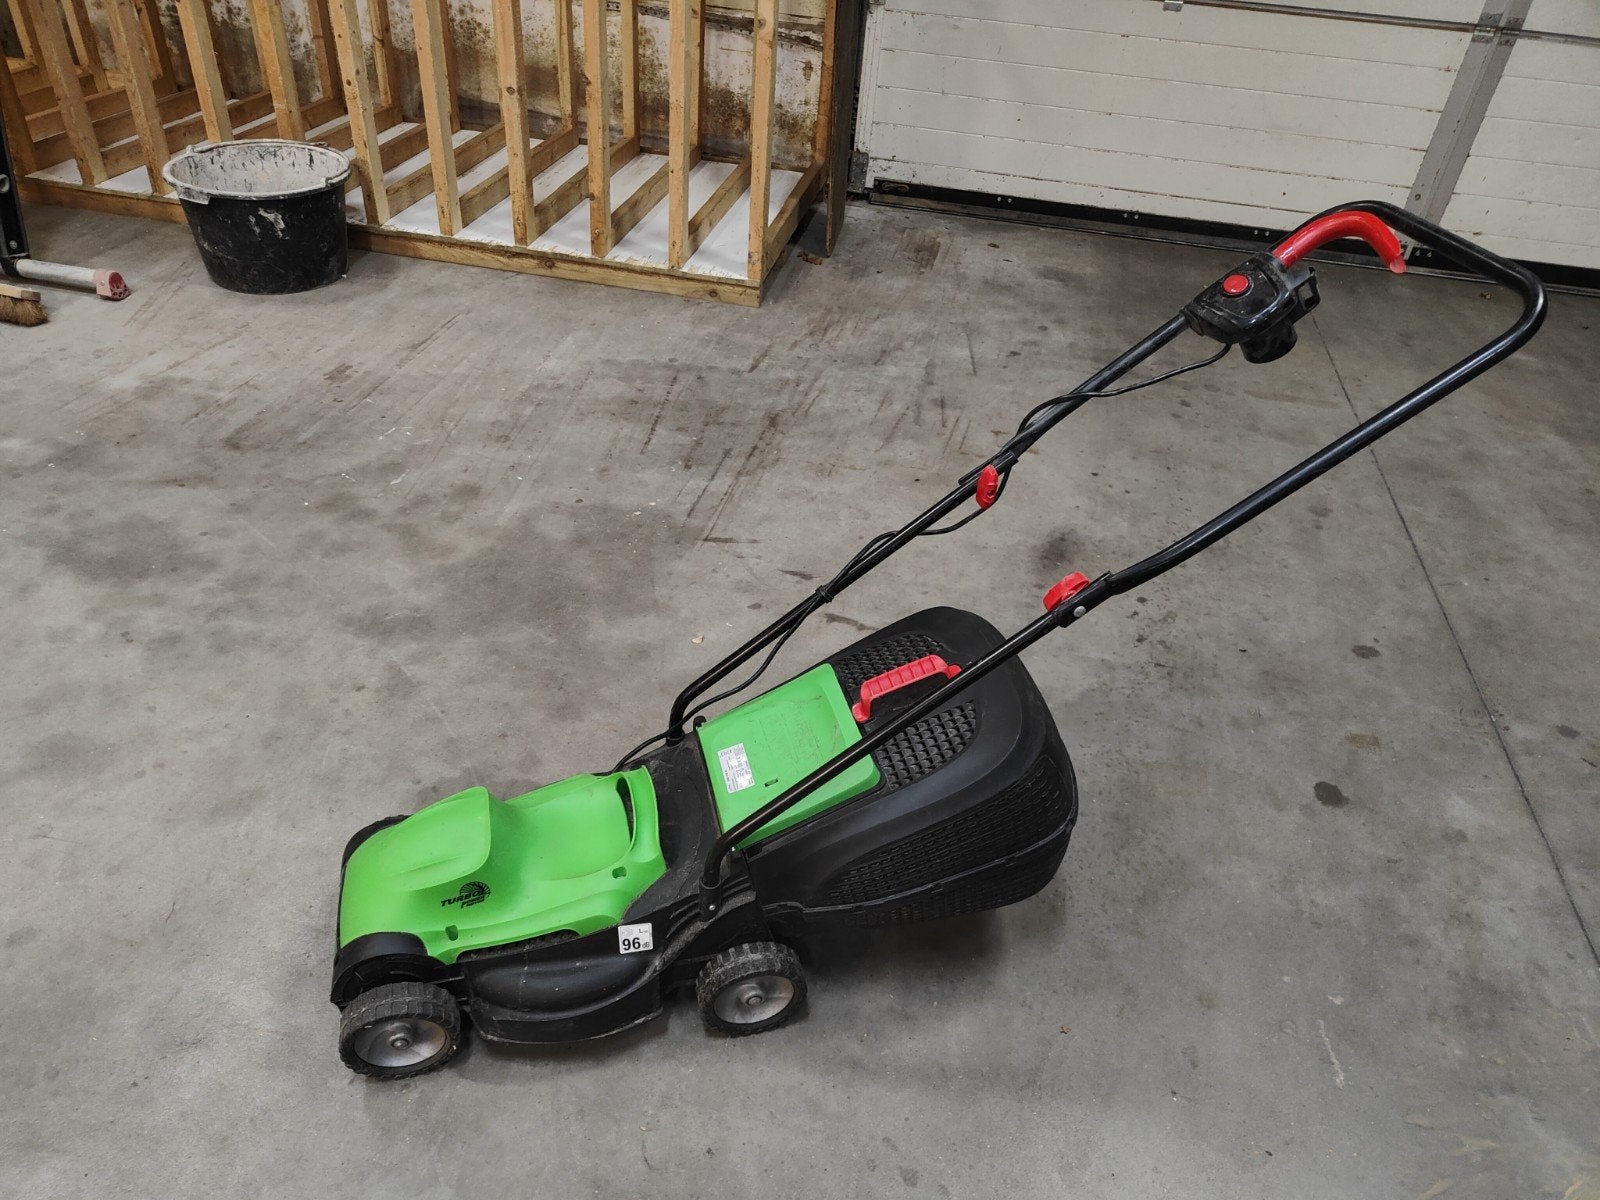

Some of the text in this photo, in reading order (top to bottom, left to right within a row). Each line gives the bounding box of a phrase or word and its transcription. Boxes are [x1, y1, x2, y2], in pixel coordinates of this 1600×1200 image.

[441, 890, 481, 907] TURBO
[622, 937, 650, 951] 96 dB
